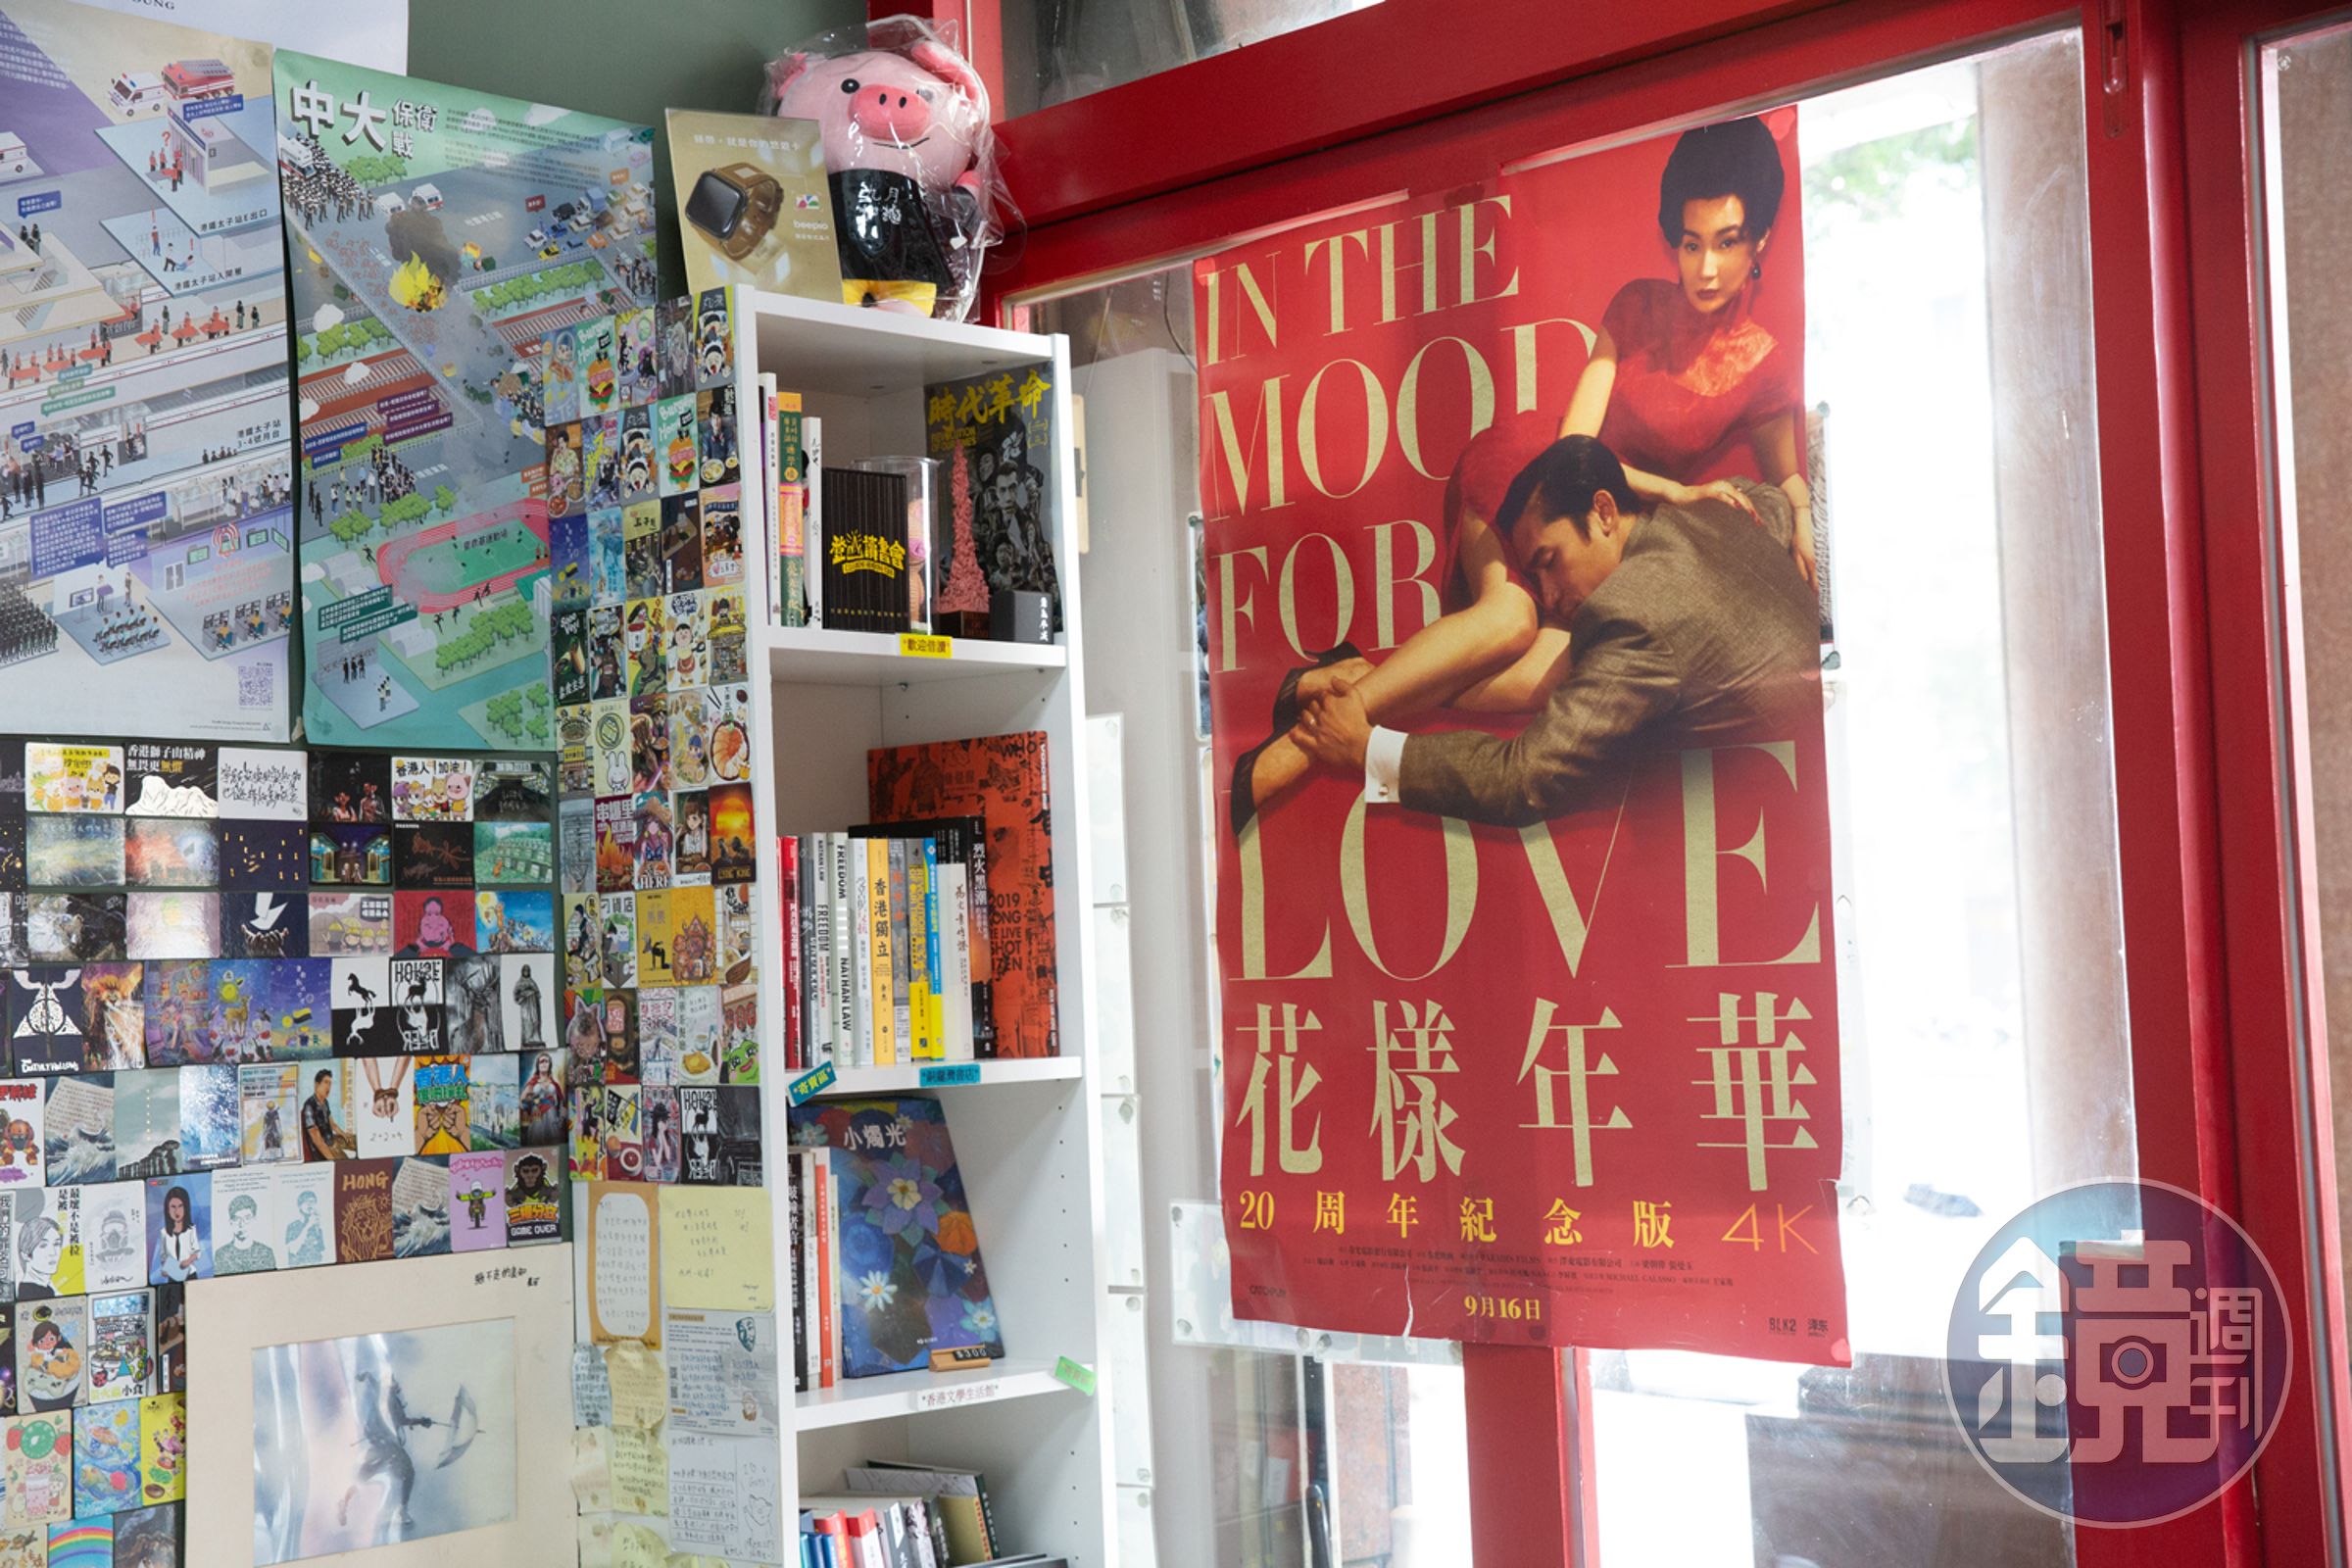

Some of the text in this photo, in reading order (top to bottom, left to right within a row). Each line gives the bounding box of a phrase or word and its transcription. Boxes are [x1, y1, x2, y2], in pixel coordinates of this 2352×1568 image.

[291, 80, 388, 152] 中大
[392, 99, 438, 132] 保衛
[392, 130, 414, 159] 戰
[1198, 195, 1519, 367] IN THE
[928, 368, 1052, 431] 時代革命
[1211, 519, 1441, 673] FOR
[837, 845, 847, 899] FREEDOM
[1228, 740, 1822, 981] LOVE
[989, 893, 1020, 908] 2019
[817, 905, 830, 952] FREEDOM
[841, 957, 852, 1031] NATHAN LAW
[1236, 991, 1819, 1192] 花樣年華
[343, 1172, 389, 1191] HONG
[511, 1225, 558, 1236] GAME OVER
[1721, 1202, 1820, 1254] 4K
[1464, 1295, 1541, 1320] 9月16日
[956, 1348, 987, 1359] $300
